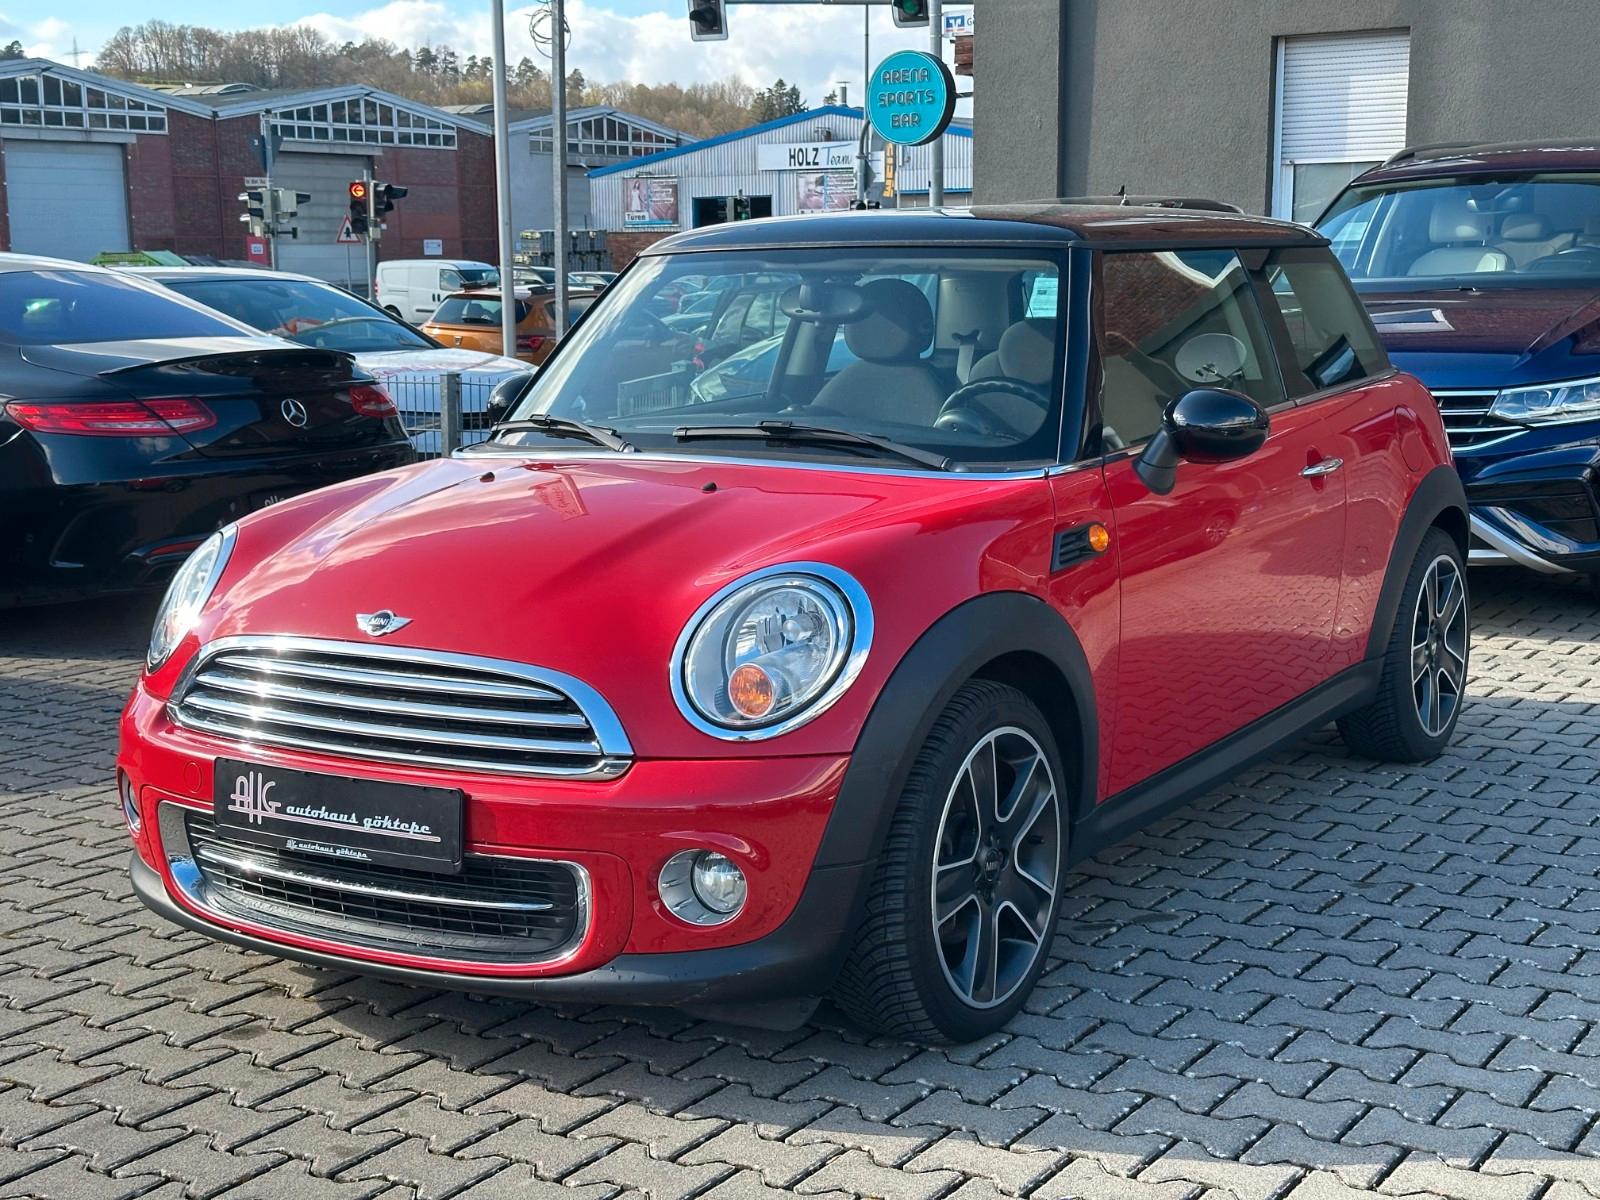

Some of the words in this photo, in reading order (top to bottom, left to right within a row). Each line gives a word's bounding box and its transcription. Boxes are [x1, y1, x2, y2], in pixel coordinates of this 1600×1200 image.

[880, 67, 930, 85] ARENA
[877, 88, 936, 107] SPORTS
[890, 112, 921, 129] BAR
[788, 147, 820, 167] HOLZ
[821, 143, 854, 166] Team
[370, 617, 390, 626] MINI
[286, 804, 359, 824] autohaus
[362, 815, 432, 834] göktepe
[298, 842, 334, 853] autohaus
